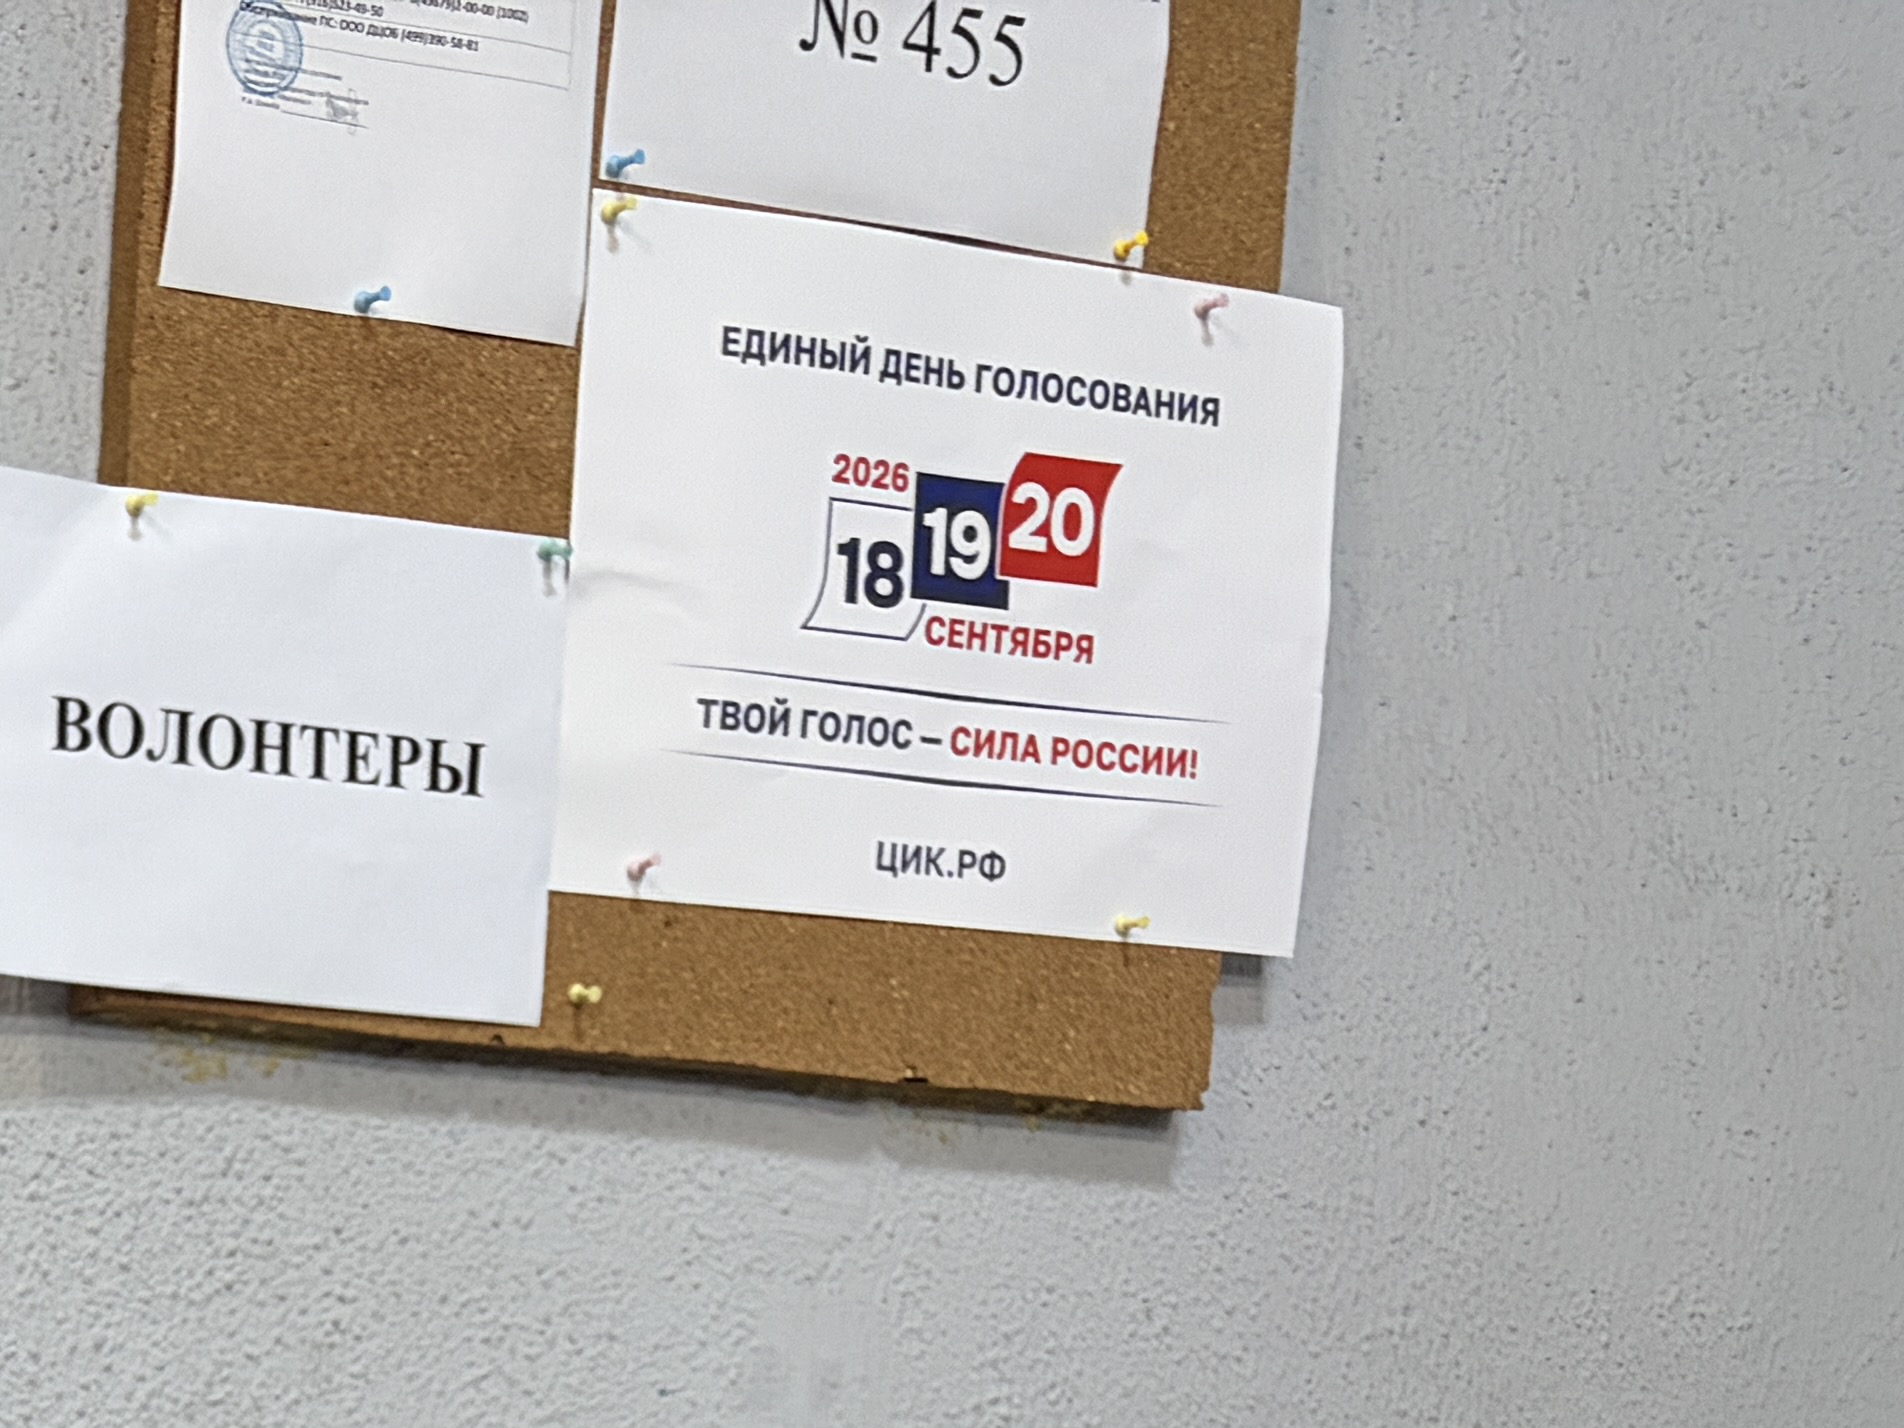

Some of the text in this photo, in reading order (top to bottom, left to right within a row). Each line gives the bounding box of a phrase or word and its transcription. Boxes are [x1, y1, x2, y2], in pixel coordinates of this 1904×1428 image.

[902, 0, 1026, 87] 455
[721, 325, 1220, 427] ЕДИНЫЙ ДЕНЬ ГОЛОСОВАНИЯ
[831, 453, 910, 493] 2026
[836, 481, 1093, 609] 18 19 20
[923, 616, 1094, 665] СЕНТЯБРЯ
[50, 691, 490, 803] ВОЛОНТЕРЫ
[696, 696, 1199, 779] ТВОЙ ГОЛОС СИЛА РОССИИ!
[874, 838, 1005, 887] ЦИК.РФ
